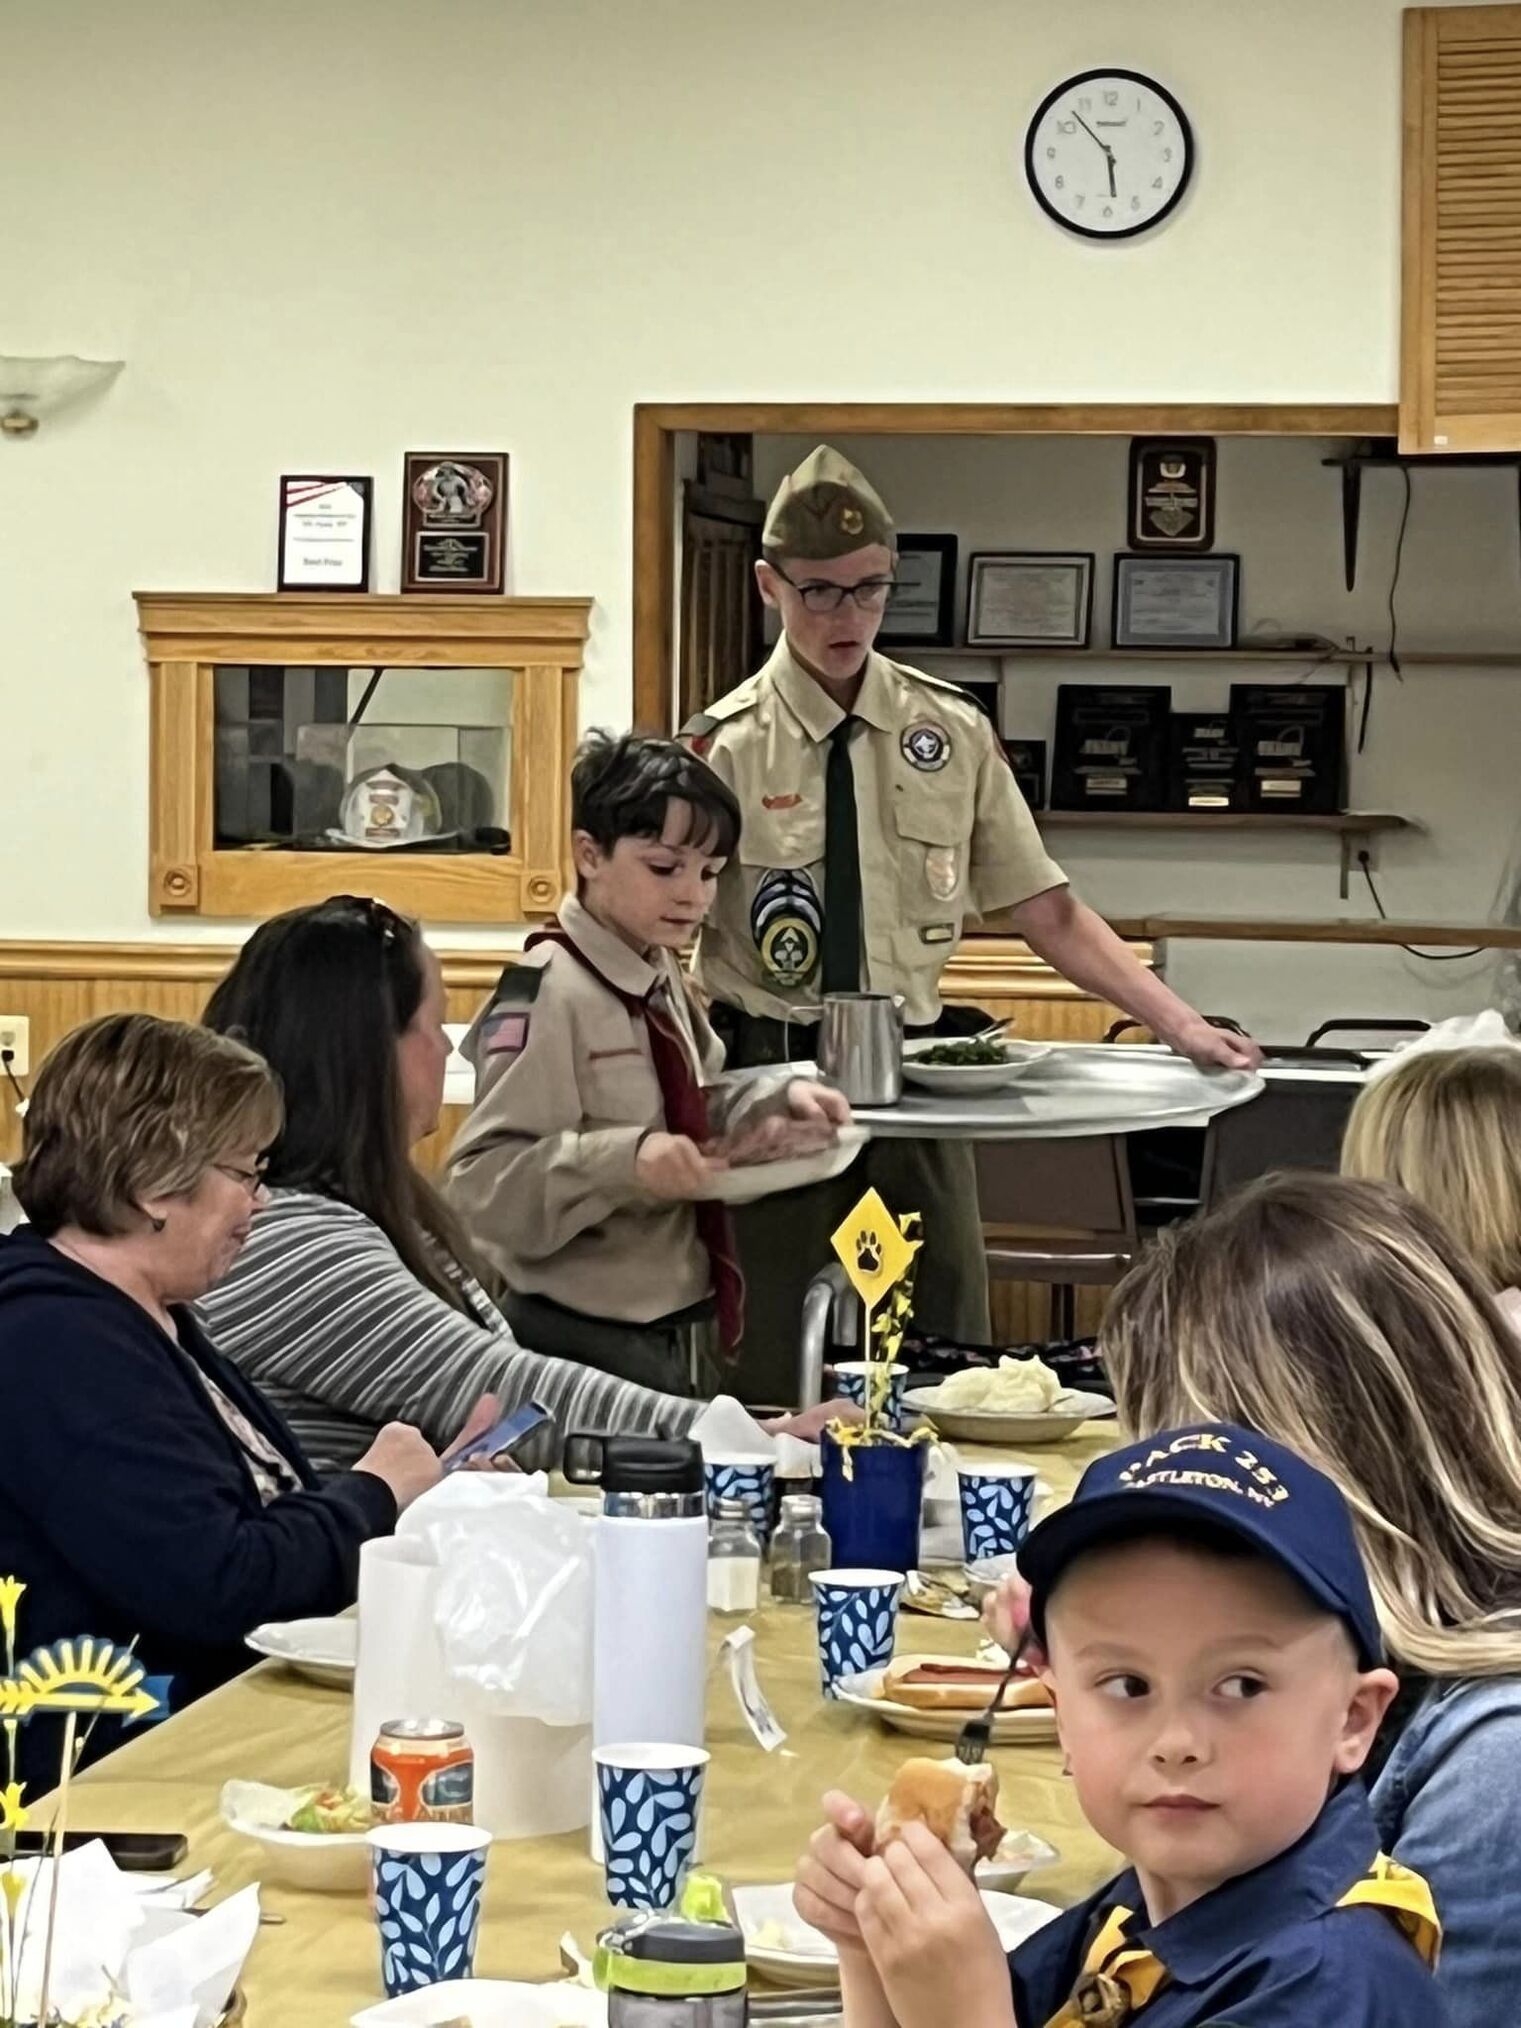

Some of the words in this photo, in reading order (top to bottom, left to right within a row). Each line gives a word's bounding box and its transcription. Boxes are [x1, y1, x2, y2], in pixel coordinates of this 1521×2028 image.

[1103, 90, 1119, 107] 12
[1153, 120, 1165, 136] 2
[1162, 147, 1172, 163] 3
[1054, 174, 1065, 190] 8
[1151, 175, 1163, 190] 4
[1075, 193, 1086, 209] 7
[1119, 1433, 1232, 1481] PACK
